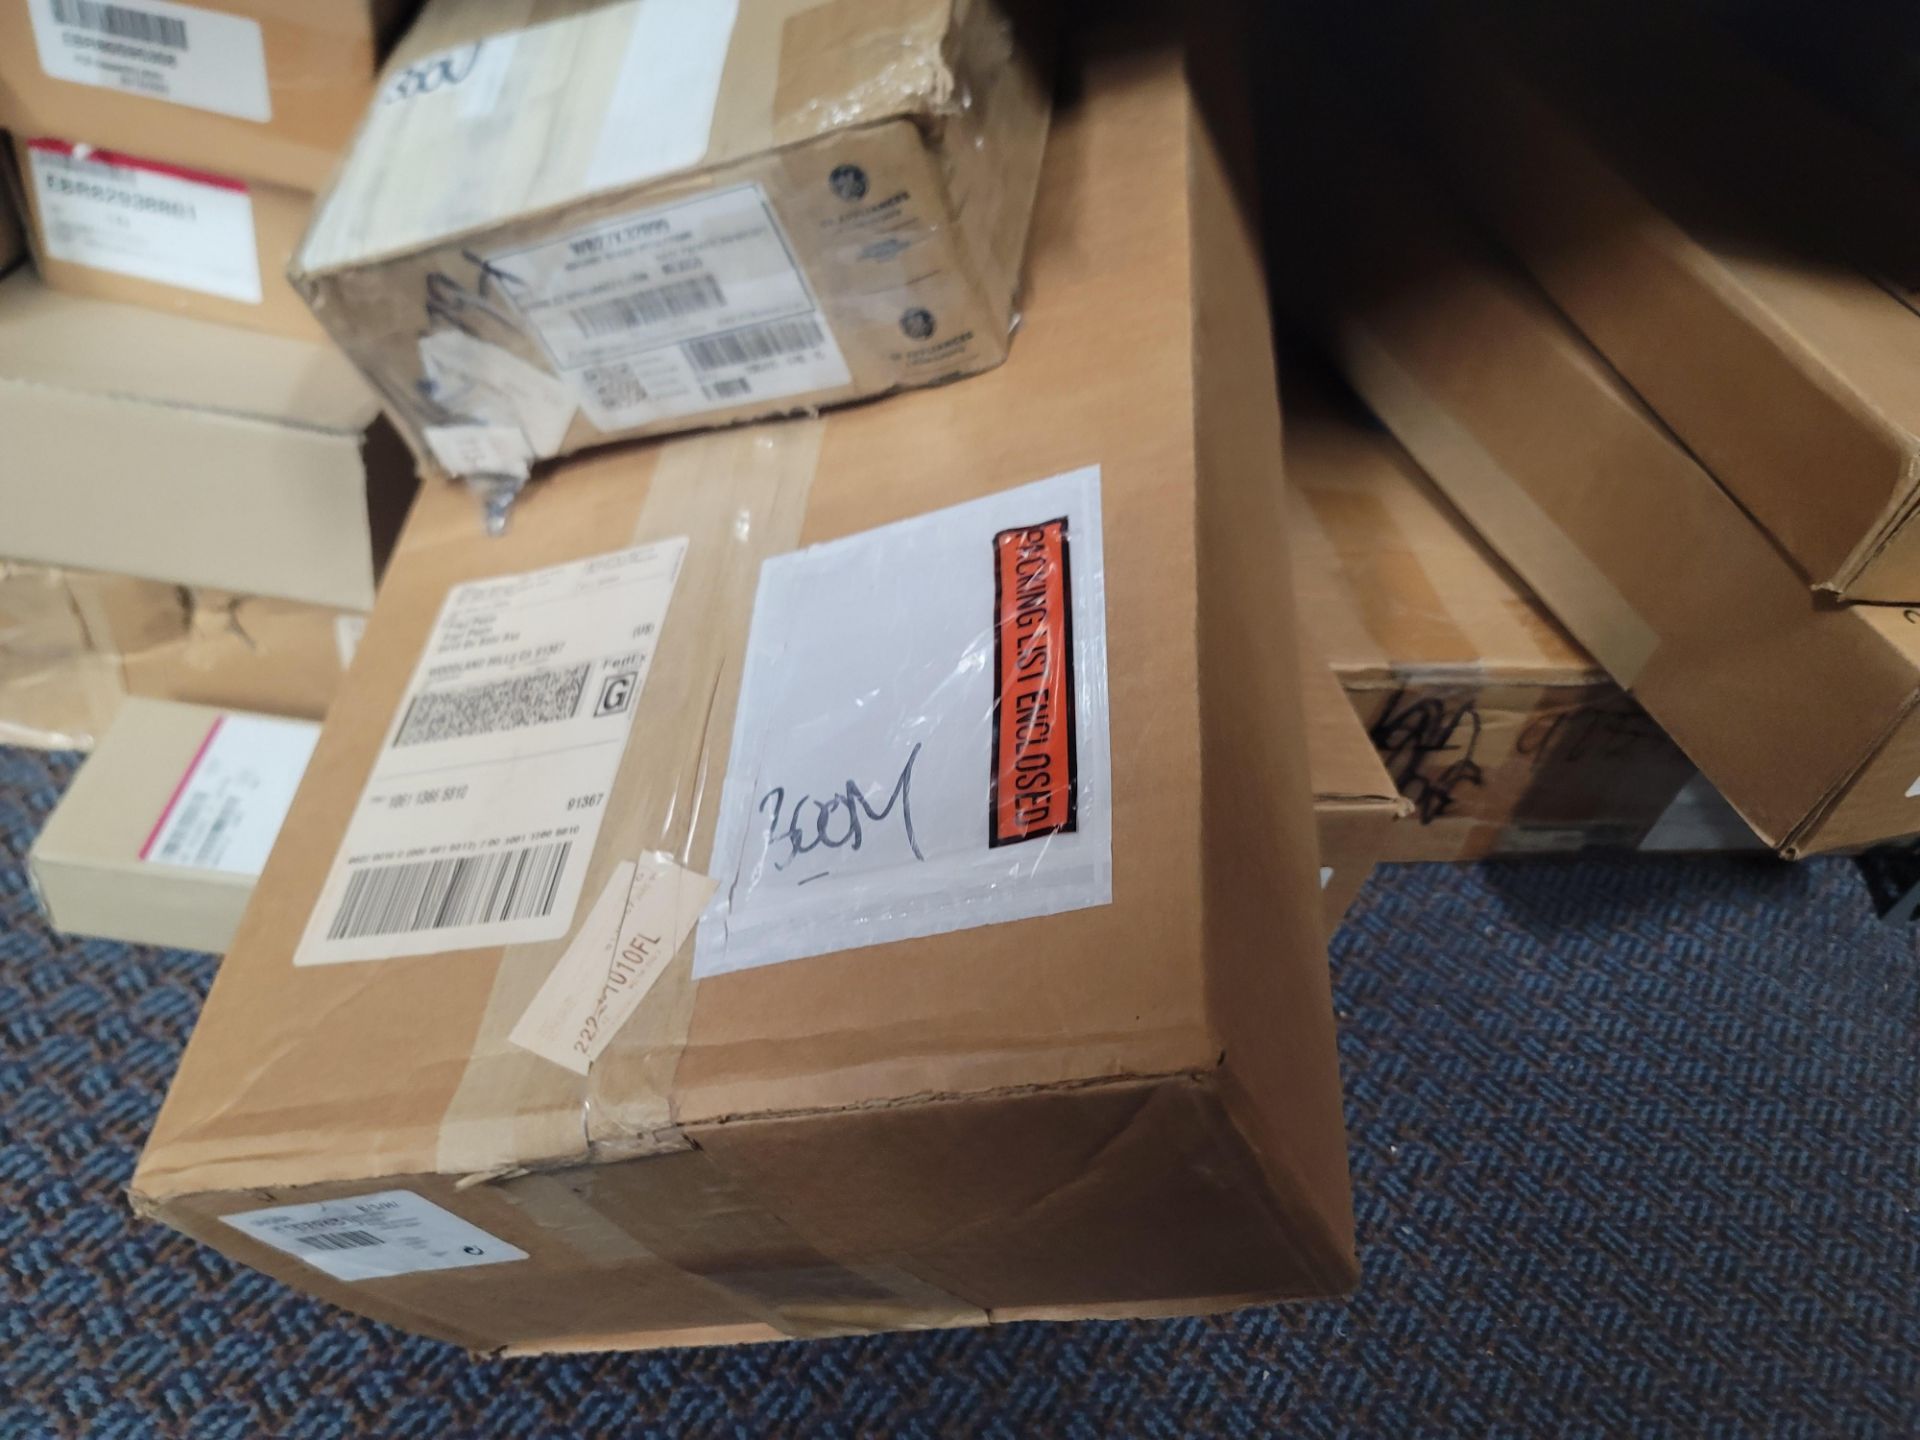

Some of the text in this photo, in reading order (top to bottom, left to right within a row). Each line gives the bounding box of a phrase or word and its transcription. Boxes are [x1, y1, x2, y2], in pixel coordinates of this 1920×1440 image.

[603, 678, 630, 711] G
[1014, 527, 1052, 830] PACKING LIST ENCLOSED
